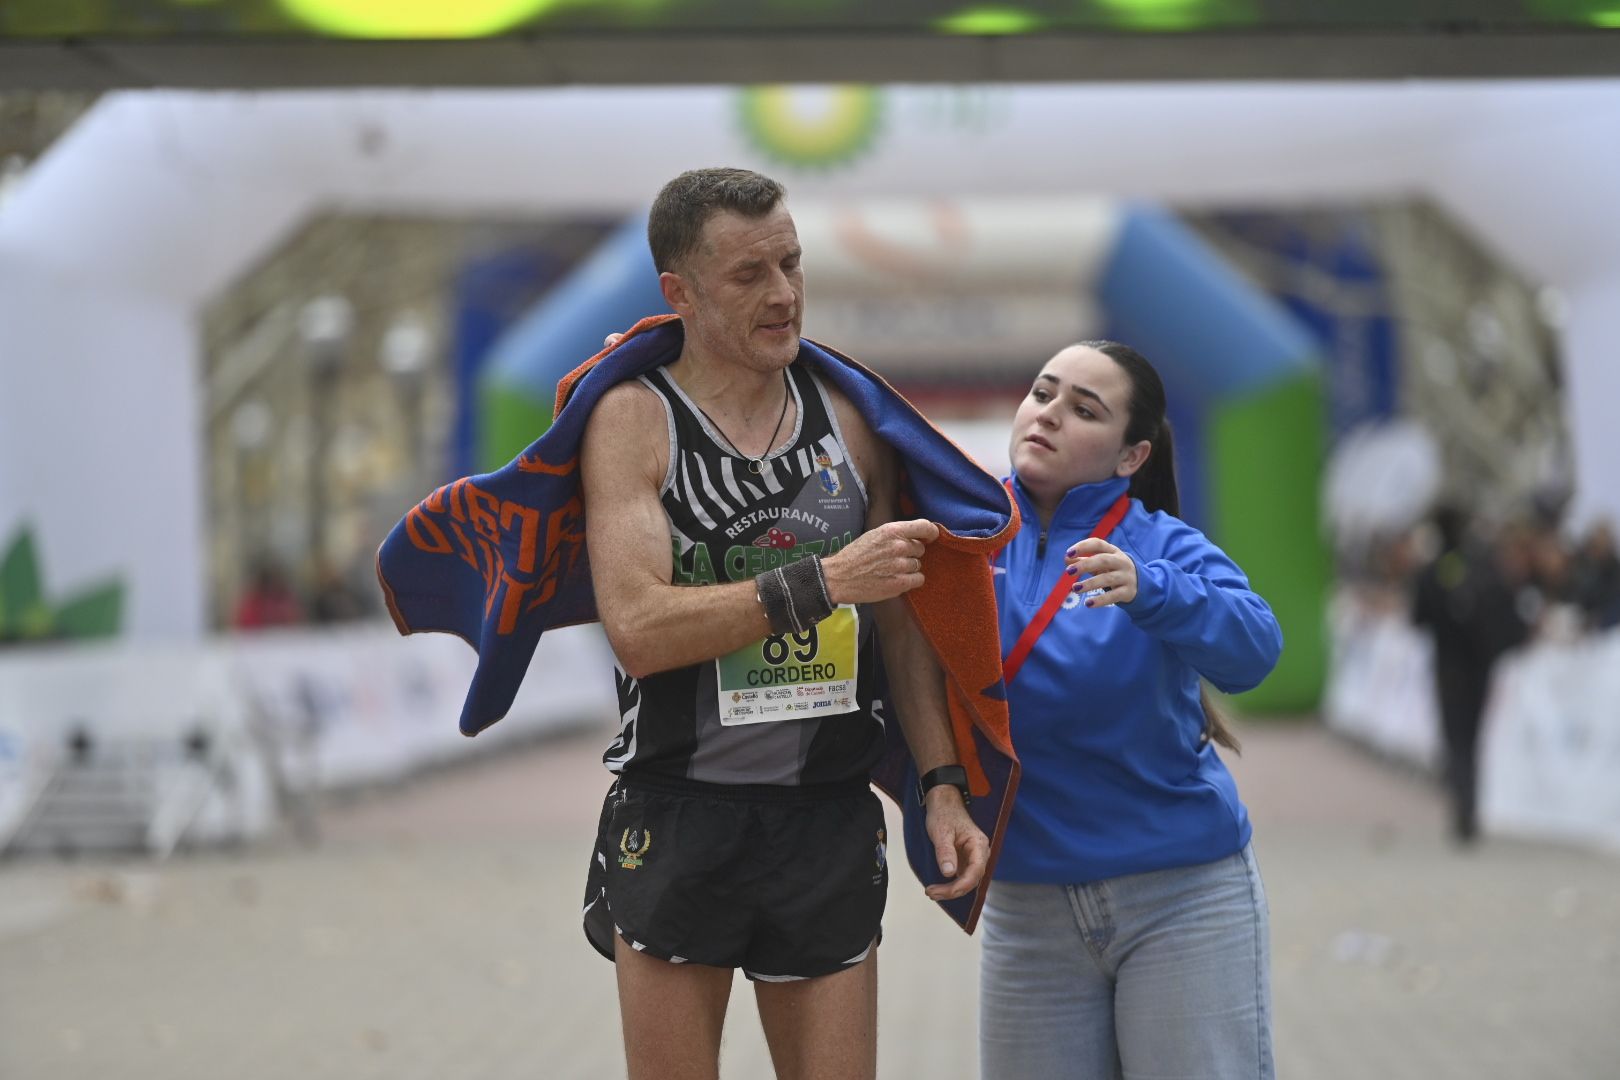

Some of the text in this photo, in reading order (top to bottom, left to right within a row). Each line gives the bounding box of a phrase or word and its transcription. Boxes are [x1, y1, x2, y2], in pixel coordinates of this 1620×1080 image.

[724, 507, 830, 540] RESTAURANTE
[671, 536, 718, 585] LA
[762, 623, 818, 666] 89
[747, 663, 836, 686] CORDERO
